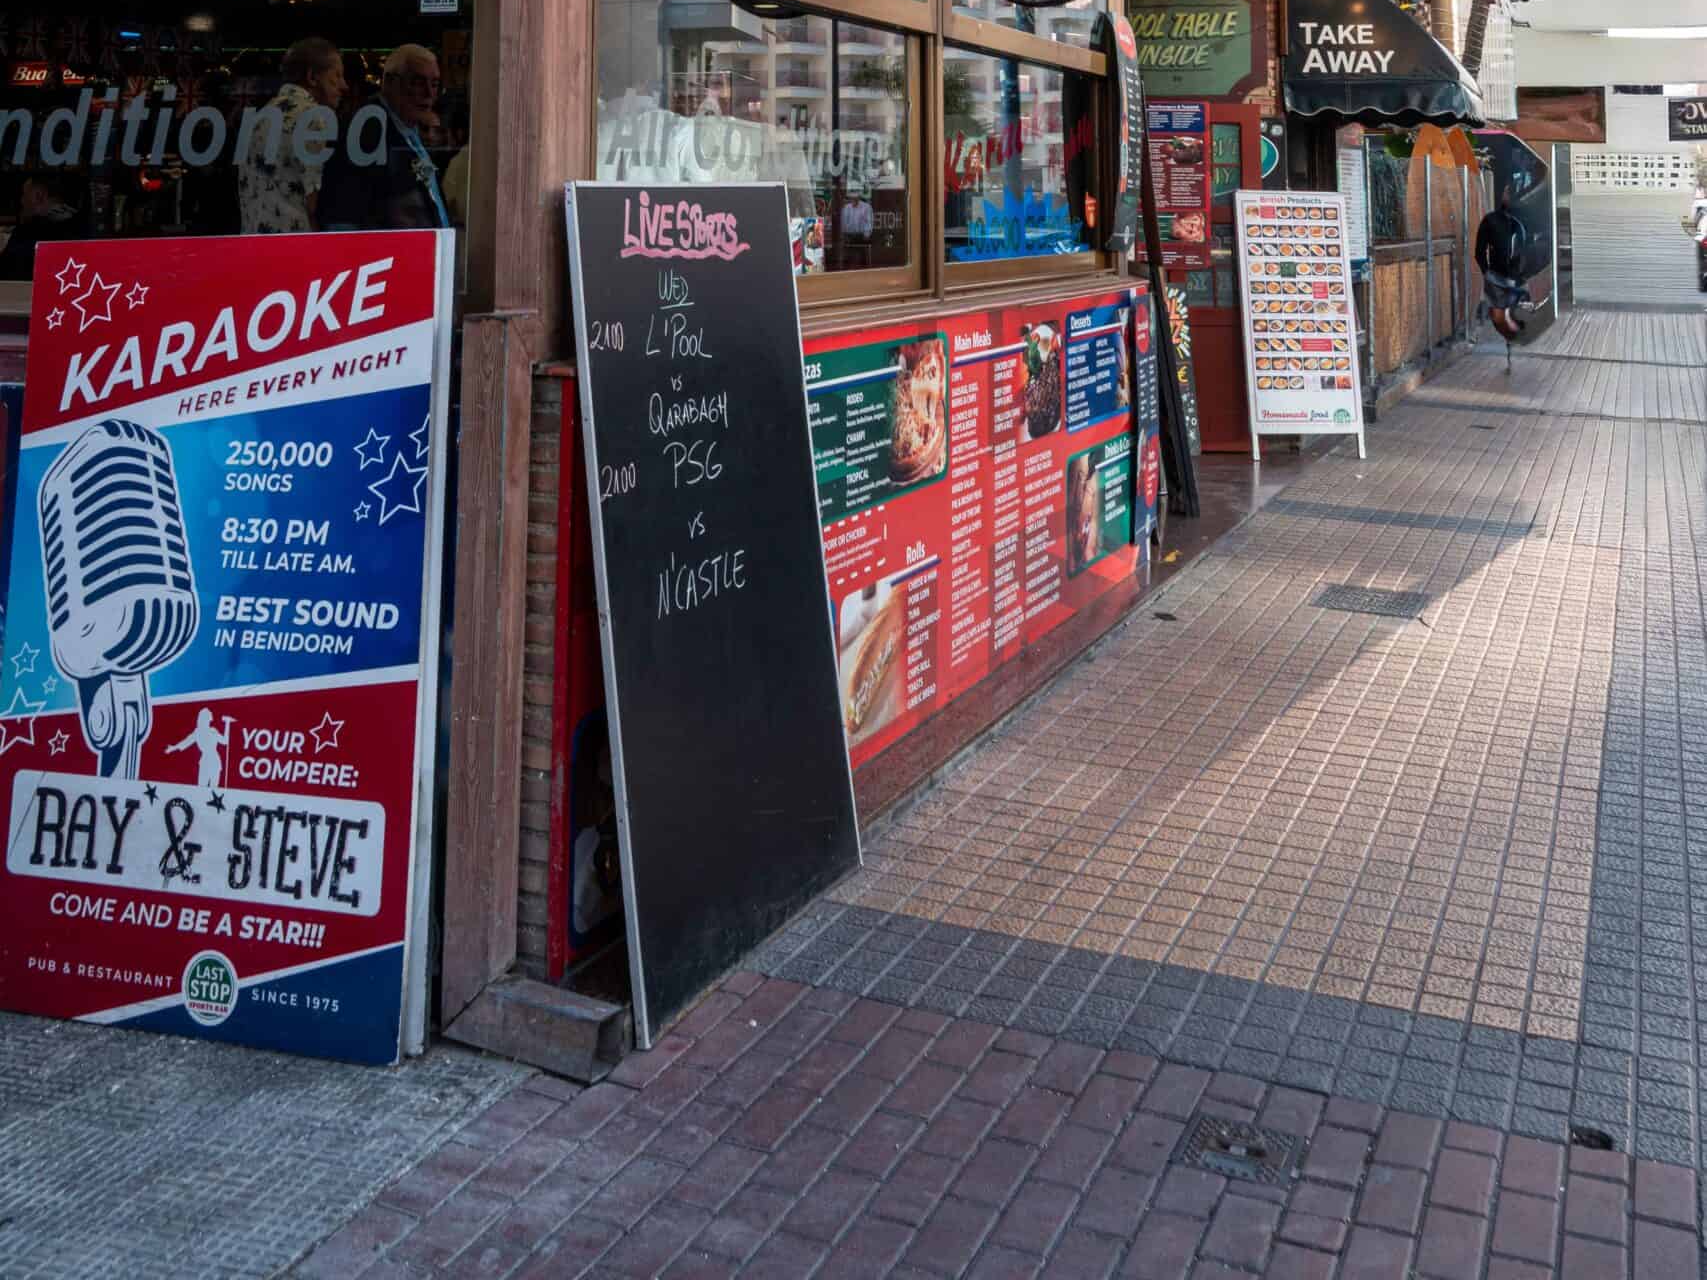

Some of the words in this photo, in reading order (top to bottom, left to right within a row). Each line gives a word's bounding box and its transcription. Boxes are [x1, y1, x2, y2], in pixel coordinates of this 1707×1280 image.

[1170, 10, 1239, 38] TABLE
[1298, 23, 1375, 45] TAKE
[1136, 44, 1209, 68] INSIDE
[1303, 51, 1395, 74] AWAY
[657, 269, 690, 304] WED
[59, 257, 393, 412] KARAOKE
[178, 386, 237, 416] HERE
[246, 366, 323, 400] EVERY
[331, 346, 407, 379] NIGHT
[225, 441, 333, 469] 250,000
[663, 440, 723, 488] PSG
[224, 473, 292, 492] SONGS
[221, 517, 277, 544] 8:30
[285, 520, 330, 546] PM
[220, 549, 259, 570] TILL
[265, 551, 313, 572] LATE
[905, 542, 926, 564] Rolls
[216, 596, 286, 623] BEST
[295, 599, 399, 630] SOUND
[214, 629, 235, 648] IN
[240, 631, 353, 655] BENIDORM
[242, 727, 305, 754] YOUR
[239, 756, 359, 788] COMPERE:
[29, 786, 141, 874] RAY
[158, 797, 202, 884] &
[228, 803, 370, 909] STEVE
[49, 891, 116, 923] COME
[120, 899, 173, 929] AND
[176, 908, 208, 934] BE
[214, 913, 233, 937] A
[239, 914, 326, 949] STAR!!!
[28, 958, 56, 971] PUB
[62, 962, 71, 974] &
[77, 963, 172, 988] RESTAURANT
[196, 965, 225, 982] LAST
[190, 979, 231, 1001] STOP
[251, 987, 298, 1006] SINCE
[305, 995, 340, 1013] 1975
